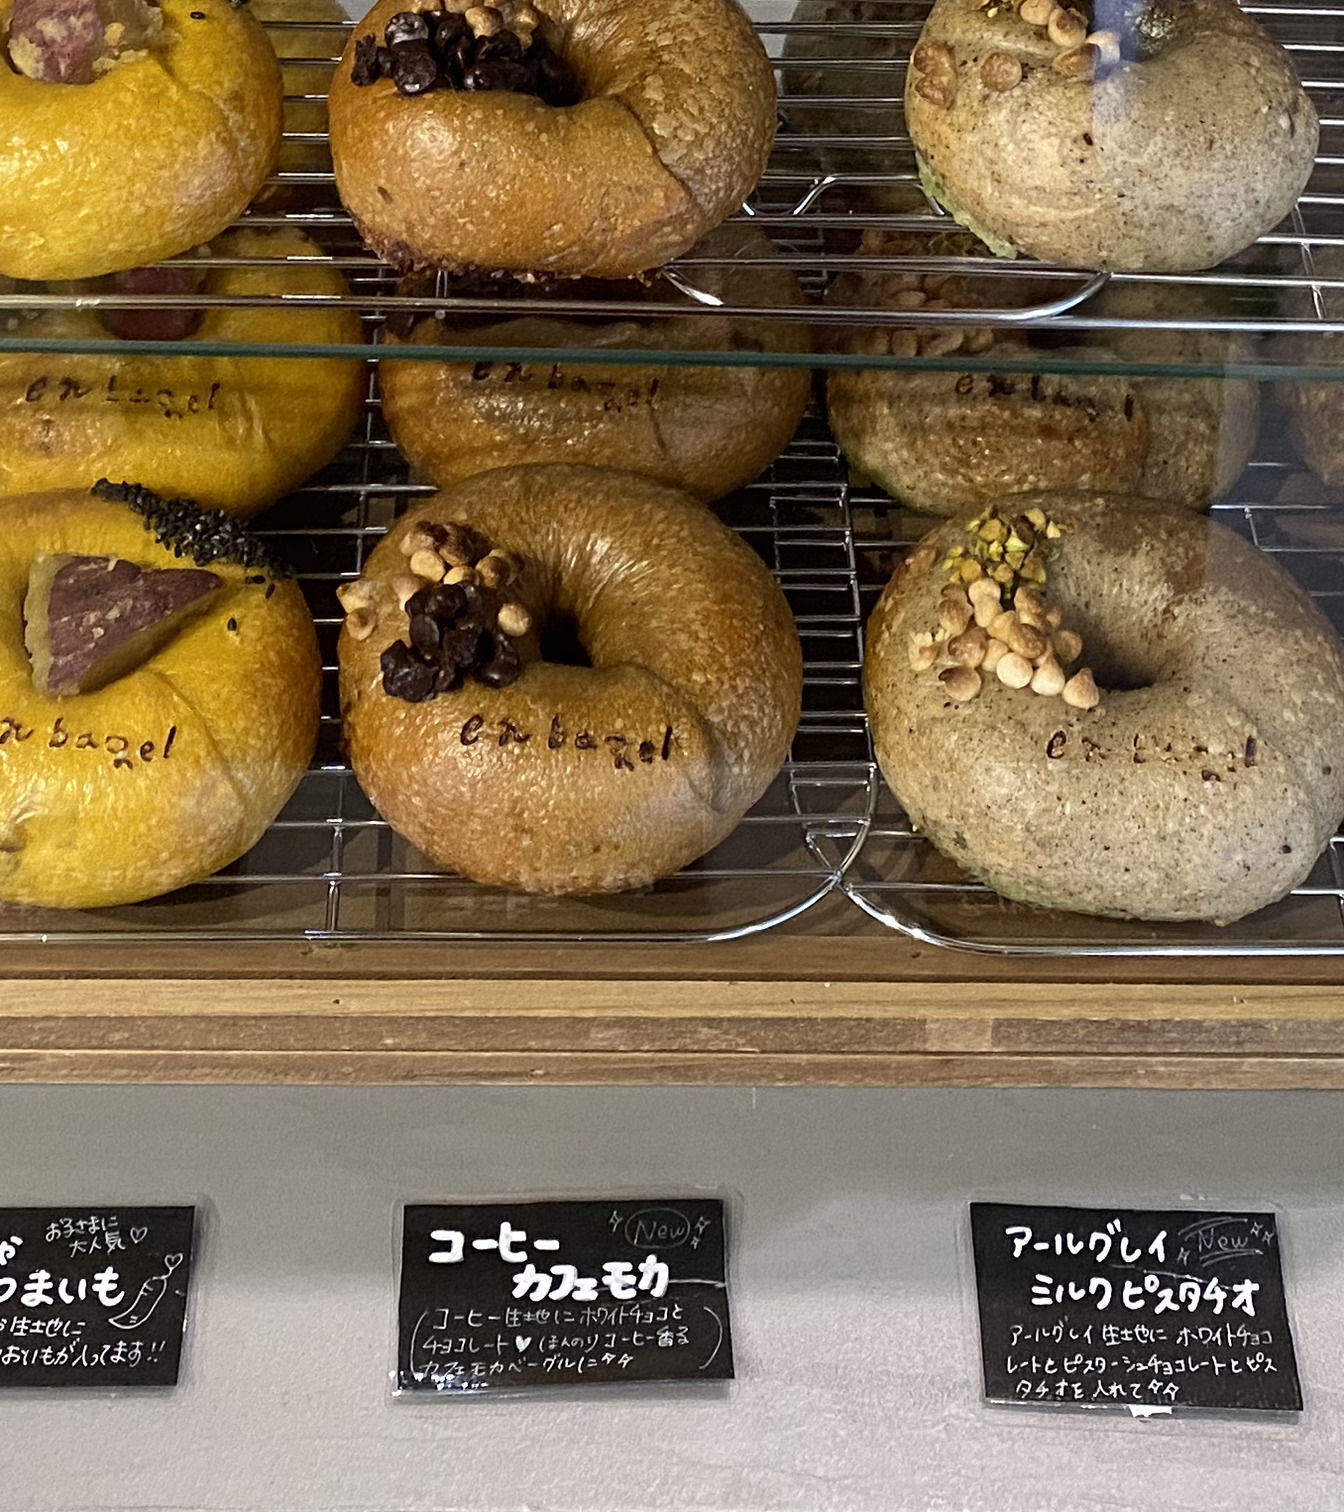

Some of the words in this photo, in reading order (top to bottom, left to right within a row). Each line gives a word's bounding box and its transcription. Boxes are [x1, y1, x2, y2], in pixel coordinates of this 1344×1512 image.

[45, 1215, 119, 1243] お子さまに
[68, 1230, 127, 1258] 大人気
[428, 1221, 560, 1263] コーヒー
[633, 1217, 687, 1246] New
[1006, 1218, 1168, 1263] アールグレイ
[1197, 1229, 1249, 1253] New
[511, 1254, 670, 1302] カフェモカ
[1031, 1274, 1260, 1317] ミルクピスタチオ
